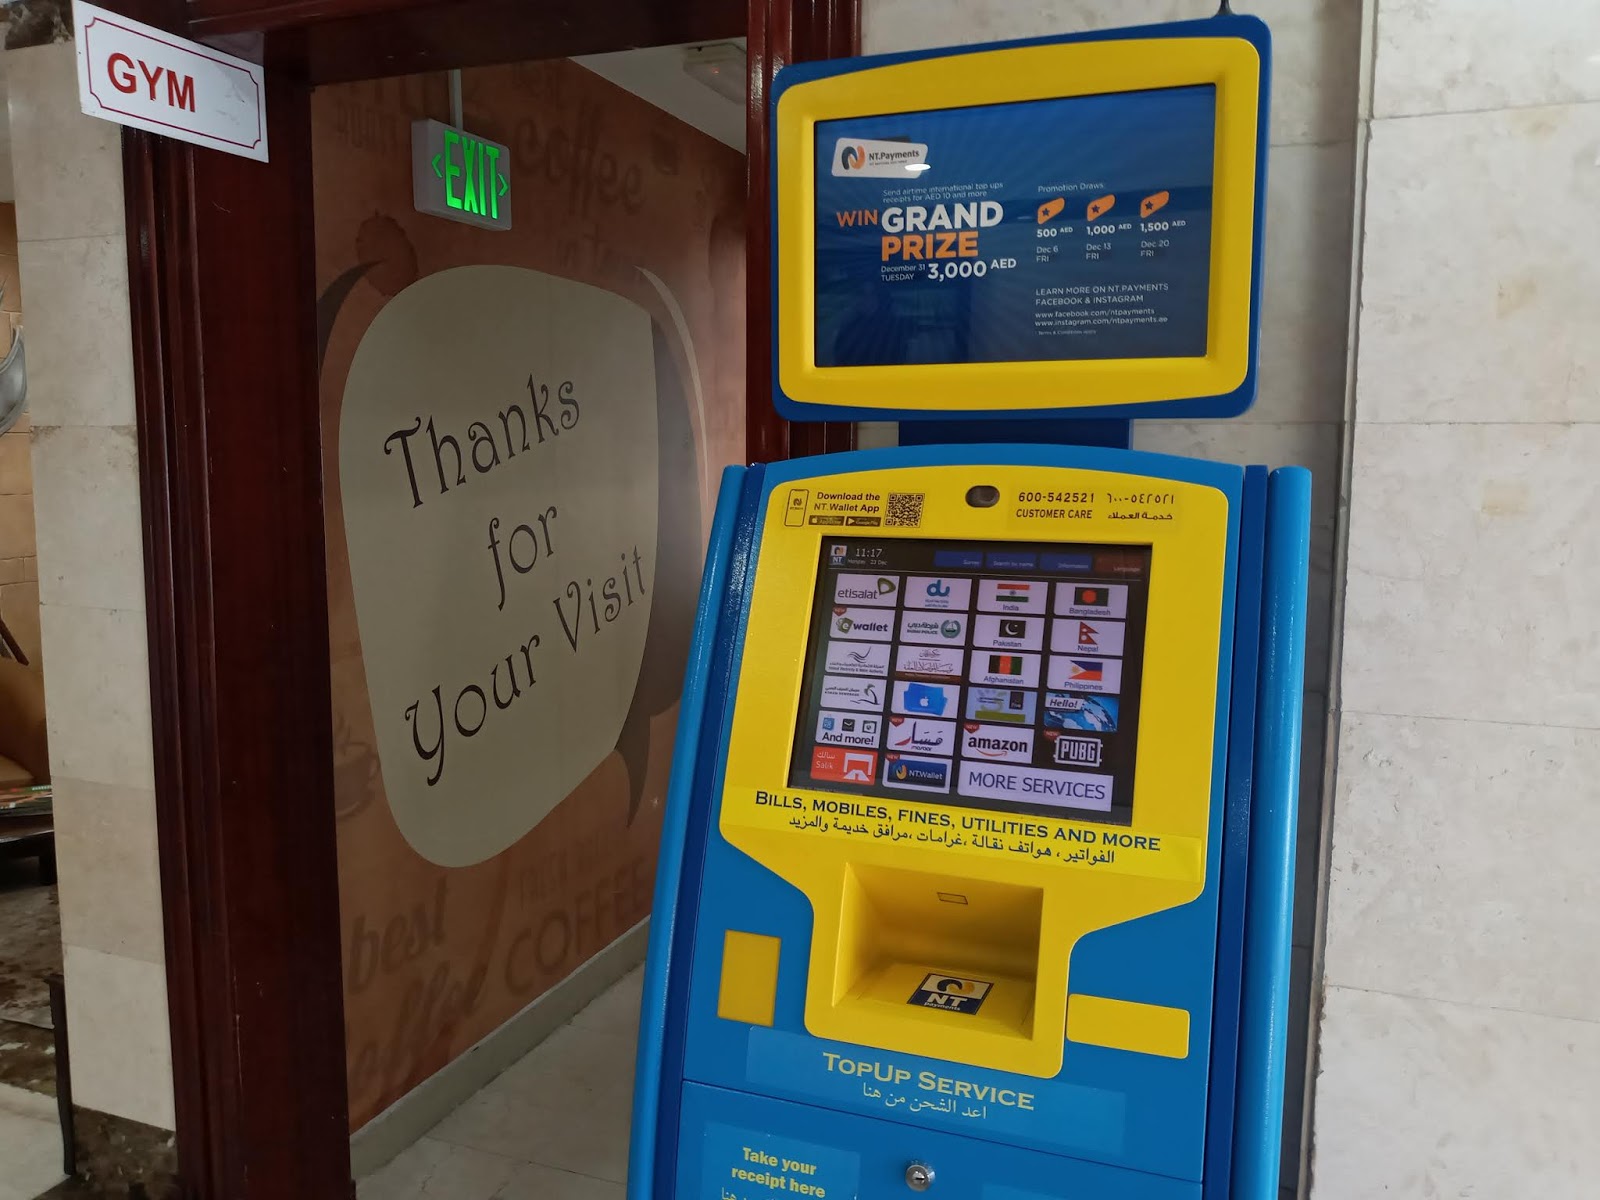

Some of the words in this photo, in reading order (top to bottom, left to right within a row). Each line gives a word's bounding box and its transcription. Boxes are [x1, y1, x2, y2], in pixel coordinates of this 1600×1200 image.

[107, 52, 196, 113] GYM
[868, 149, 920, 162] NT.Payments
[443, 129, 500, 220] EXIT
[883, 188, 901, 197] Send
[902, 186, 927, 195] airtime
[929, 183, 974, 194] international
[975, 182, 989, 192] top
[990, 181, 1004, 191] ups
[1037, 184, 1079, 193] Promotion
[883, 194, 911, 204] receipts
[912, 194, 924, 202] for
[925, 192, 942, 201] AED
[943, 192, 951, 200] 10
[952, 191, 966, 200] and
[967, 190, 988, 199] more
[836, 208, 879, 228] WIN
[881, 200, 1004, 234] GRAND
[1036, 228, 1058, 238] 500
[1086, 225, 1116, 236] 1,000
[1140, 221, 1169, 233] 1,500
[881, 231, 979, 262] PRIZE
[1086, 243, 1102, 251] Dec
[1158, 239, 1170, 247] 20
[1036, 246, 1052, 254] Dec
[1086, 252, 1100, 260] FRI
[1036, 255, 1050, 263] FRI
[881, 264, 917, 273] December
[918, 263, 926, 271] 31
[927, 261, 987, 283] 3,000
[990, 258, 1017, 270] AED
[881, 273, 915, 282] TUESDAY
[1036, 287, 1064, 296] LEARN
[1065, 286, 1091, 295] MORE
[1092, 285, 1106, 293] ON
[1108, 283, 1169, 293] NT.PAYMENTS
[1036, 297, 1083, 306] FACEBOOK
[1093, 294, 1144, 304] INSTAGRAM
[1035, 308, 1155, 319] www.facebook.com/ntpayments
[1035, 315, 1168, 327] www.instagram.com/ntpayments.ae
[384, 373, 580, 509] Thanks
[816, 492, 863, 501] Download
[865, 492, 880, 501] the
[1018, 492, 1094, 503] 600-542521
[813, 503, 858, 512] NT.Wallet
[860, 504, 880, 513] App
[1016, 509, 1065, 519] CUSTOMER
[1068, 510, 1093, 519] CARE
[487, 505, 558, 612] for
[855, 548, 883, 558] 11:17
[837, 588, 878, 600] etisalat
[926, 579, 951, 597] du
[552, 545, 646, 654] Visit
[1069, 607, 1112, 616] Bangladesh
[853, 621, 889, 633] wallet
[992, 639, 1022, 648] Pakistan
[1078, 645, 1099, 653] Nepal
[983, 675, 1024, 685] Afghanistan
[1064, 681, 1103, 691] Philippines
[1050, 699, 1078, 708] Hello!
[822, 732, 844, 742] And
[844, 734, 874, 746] more!
[968, 736, 1028, 753] amazon
[1061, 740, 1096, 761] PUBG
[815, 761, 833, 770] Salik
[968, 771, 1017, 791] MORE
[1022, 777, 1106, 800] SERVICES
[755, 791, 807, 812] BILLS,
[812, 800, 892, 821] MOBILES,
[898, 809, 955, 829] FINES,
[962, 816, 1048, 838] UTILITIES
[1054, 827, 1096, 844] AND
[1102, 832, 1161, 851] MORE
[789, 815, 829, 833] والمزيد
[972, 833, 1004, 850] نقالة
[1009, 841, 1052, 859] هواتف
[924, 1001, 961, 1011] payments
[926, 993, 968, 1007] NT
[863, 1082, 882, 1099] هنا
[918, 1071, 1035, 1111] SERVICE
[885, 1093, 906, 1107] من
[909, 1098, 957, 1113] الشحن
[962, 1105, 987, 1119] اعد
[742, 1146, 778, 1167] Take
[781, 1158, 817, 1176] your
[731, 1167, 786, 1190] receipt
[789, 1178, 826, 1199] here
